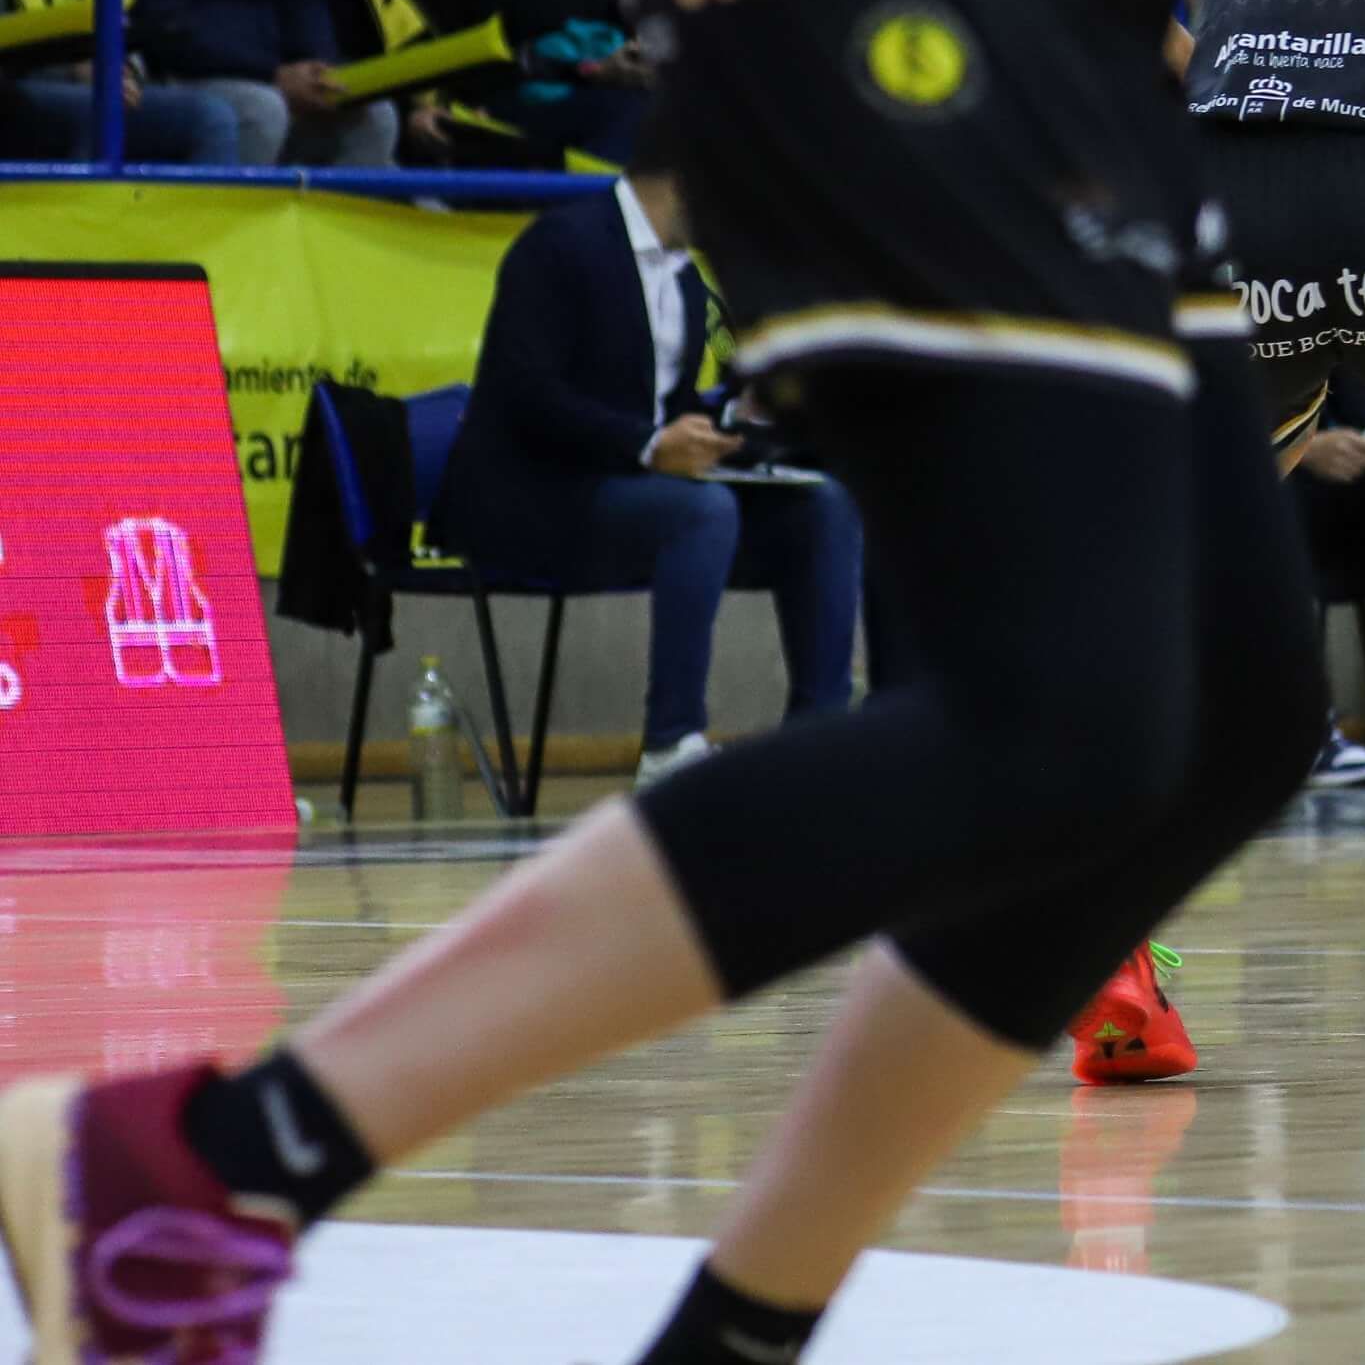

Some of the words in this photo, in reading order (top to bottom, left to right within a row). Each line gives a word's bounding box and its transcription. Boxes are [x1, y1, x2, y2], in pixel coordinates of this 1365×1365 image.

[1253, 52, 1265, 67] la
[1314, 56, 1345, 69] nace
[1292, 97, 1316, 109] de
